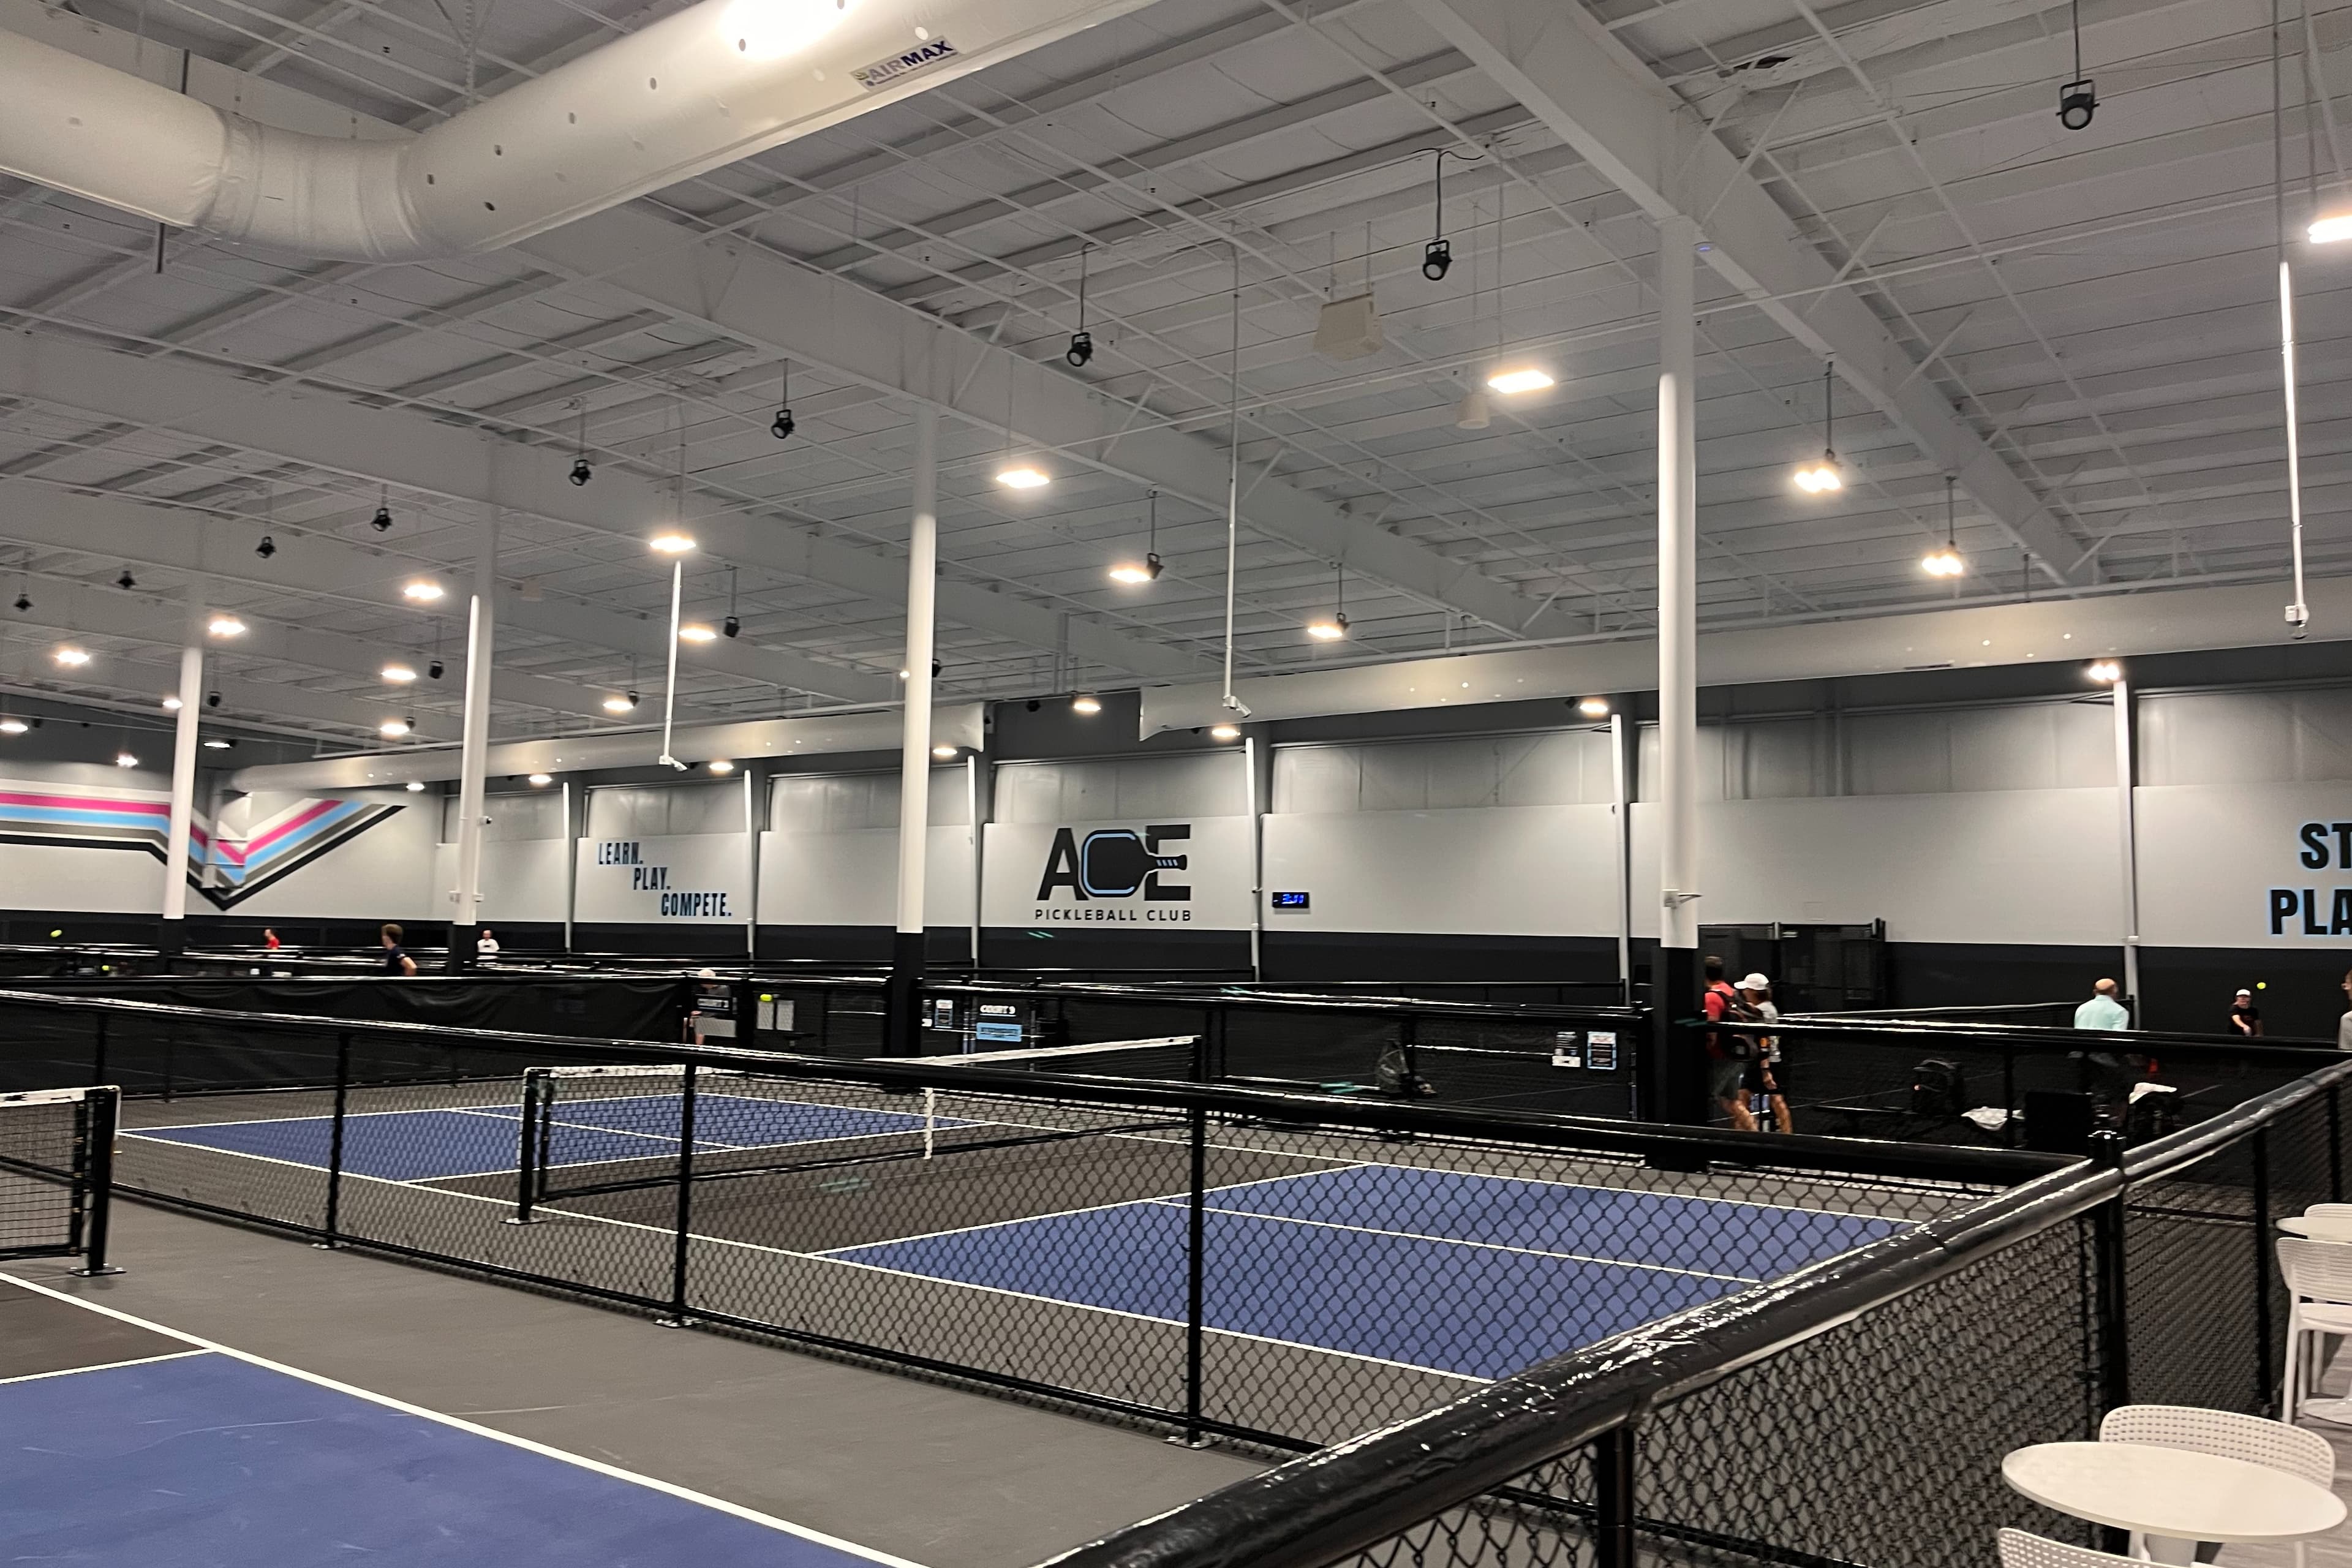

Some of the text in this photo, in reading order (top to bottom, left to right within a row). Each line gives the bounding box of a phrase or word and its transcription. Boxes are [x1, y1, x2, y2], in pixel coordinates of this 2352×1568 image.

[869, 40, 954, 80] AIRMAX
[598, 842, 644, 865] LEARN.
[1036, 824, 1191, 901] ACE
[633, 867, 671, 890] PLAY.
[661, 892, 733, 916] COMPETE.
[1035, 909, 1191, 922] PICKLEBALL CLUB
